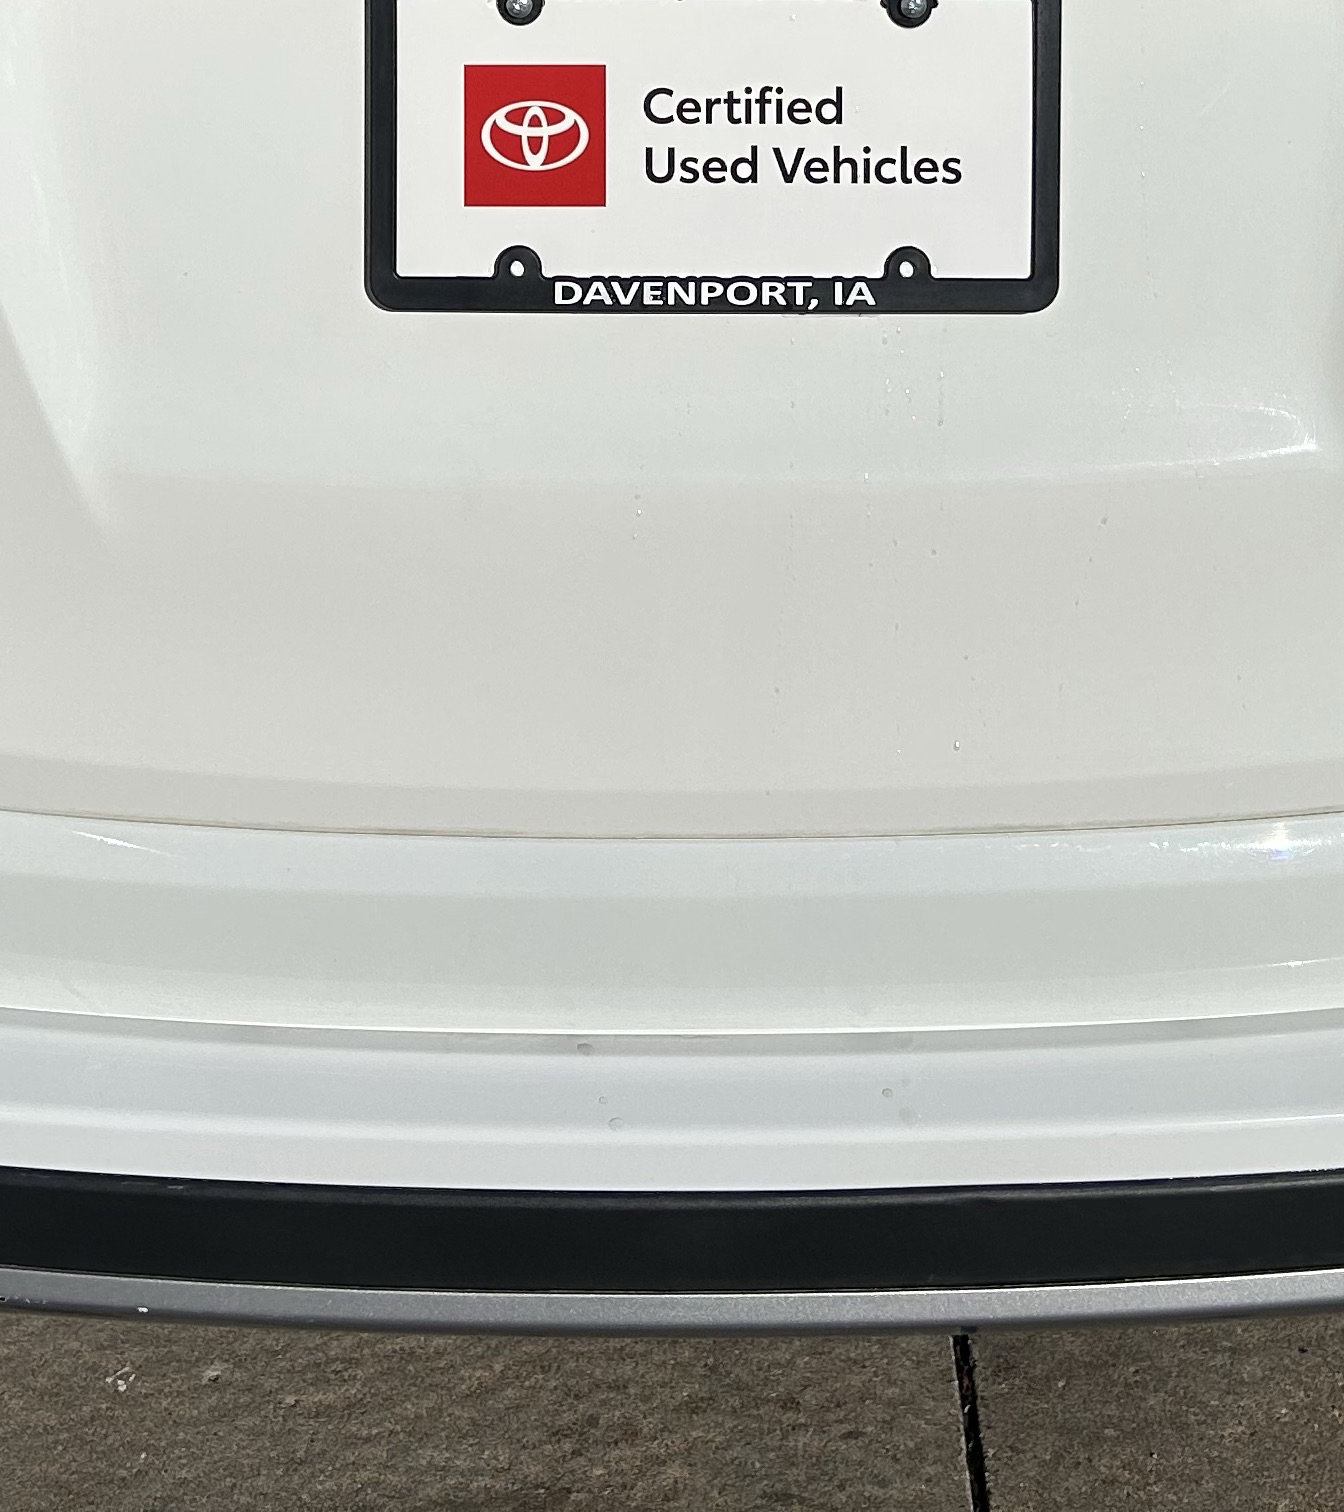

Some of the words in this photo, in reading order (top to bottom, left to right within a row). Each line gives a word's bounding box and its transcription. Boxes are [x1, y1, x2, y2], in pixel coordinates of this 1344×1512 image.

[642, 85, 844, 126] Certified
[643, 146, 758, 185] Used
[773, 145, 963, 186] Vehicles
[553, 280, 820, 310] DAVENPORT,
[833, 281, 877, 307] IA
